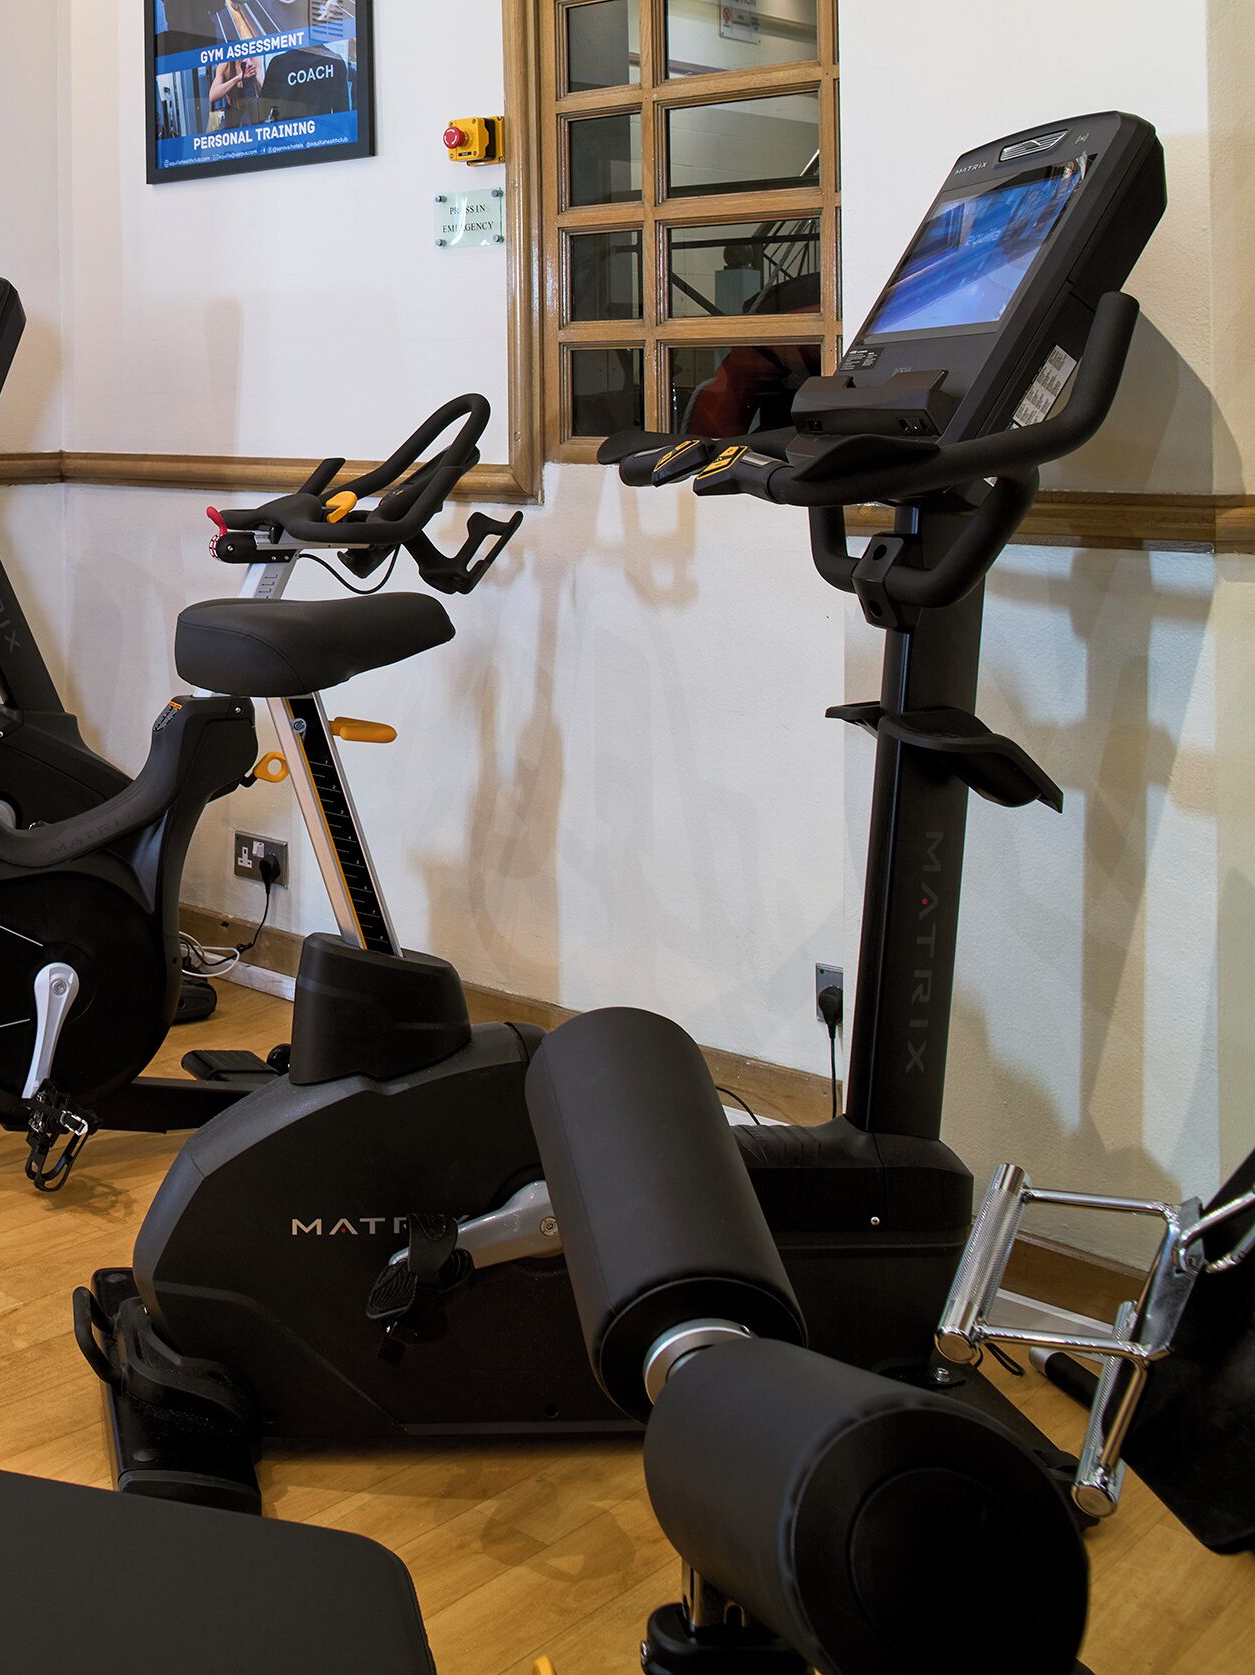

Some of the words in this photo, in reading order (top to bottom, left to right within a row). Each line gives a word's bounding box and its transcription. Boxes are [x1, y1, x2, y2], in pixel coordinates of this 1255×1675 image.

[200, 47, 223, 63] GYM
[226, 32, 304, 59] ASSESSMENT
[287, 64, 334, 86] COACH
[193, 130, 253, 151] PERSONAL
[255, 119, 316, 141] TRAINING
[475, 204, 486, 213] IN
[442, 221, 494, 233] EMGENCY
[904, 830, 945, 1074] MATRIX
